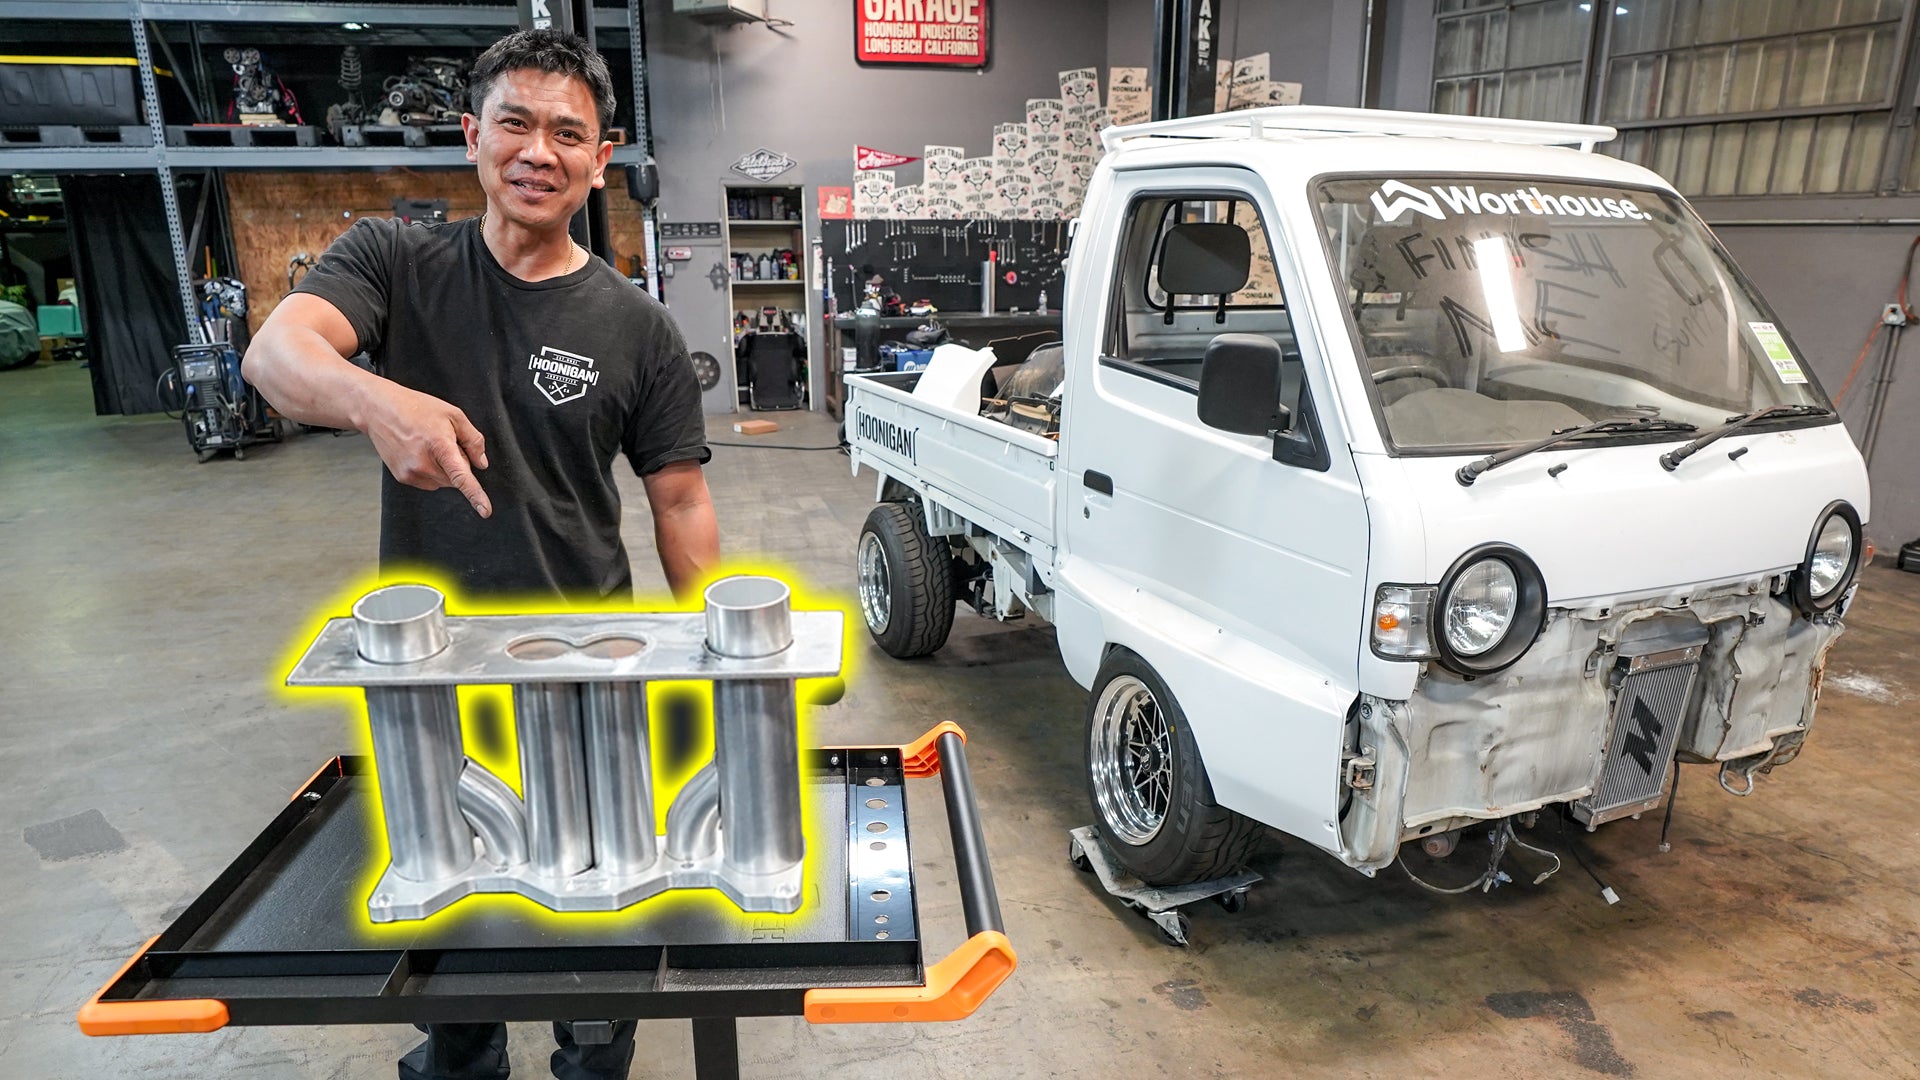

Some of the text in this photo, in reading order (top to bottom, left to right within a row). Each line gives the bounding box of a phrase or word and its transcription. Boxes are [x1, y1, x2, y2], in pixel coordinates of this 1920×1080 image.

[864, 0, 979, 24] GARAGE
[864, 22, 979, 40] HOONIGAN INDUSTRIES
[865, 38, 979, 56] LONG BEACH CALIFORNIA
[1016, 125, 1027, 136] TRA
[1047, 148, 1059, 157] TRA
[1051, 199, 1063, 209] TRA
[1430, 185, 1652, 221] Worthouse.
[531, 355, 596, 384] HOONIGAN
[858, 410, 913, 459] HOONIGAN
